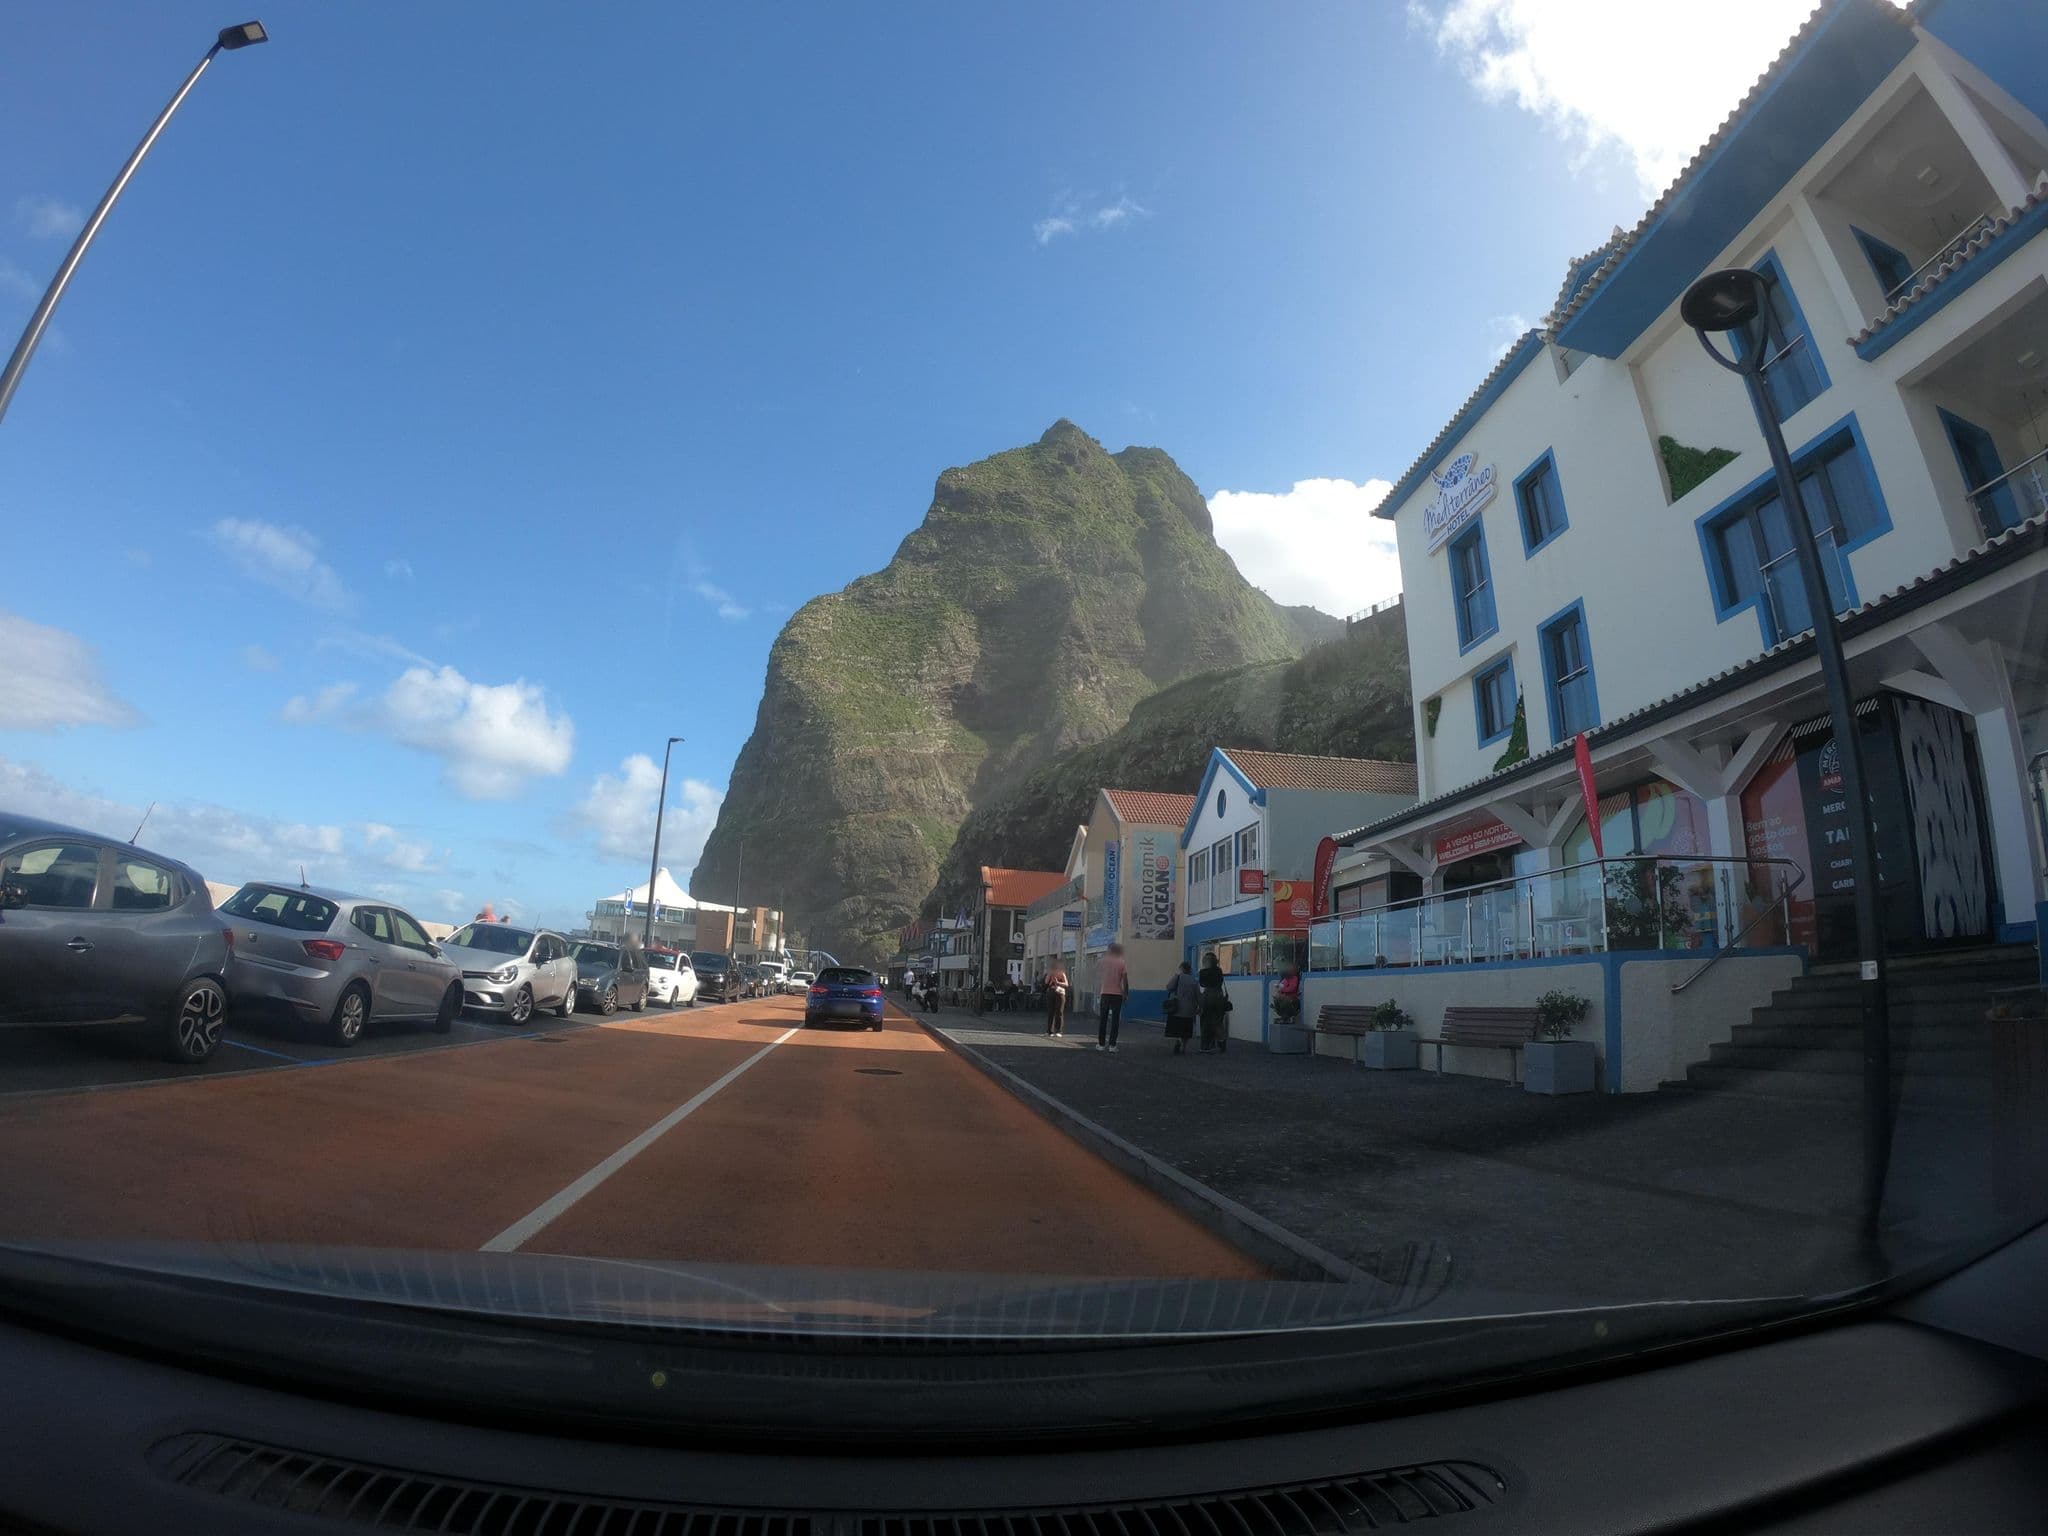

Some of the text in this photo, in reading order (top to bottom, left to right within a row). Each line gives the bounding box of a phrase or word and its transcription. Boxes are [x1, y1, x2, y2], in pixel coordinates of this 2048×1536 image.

[1446, 509, 1471, 535] HOTEL
[1108, 850, 1116, 880] OCEAN
[1138, 836, 1154, 925] Panoramik
